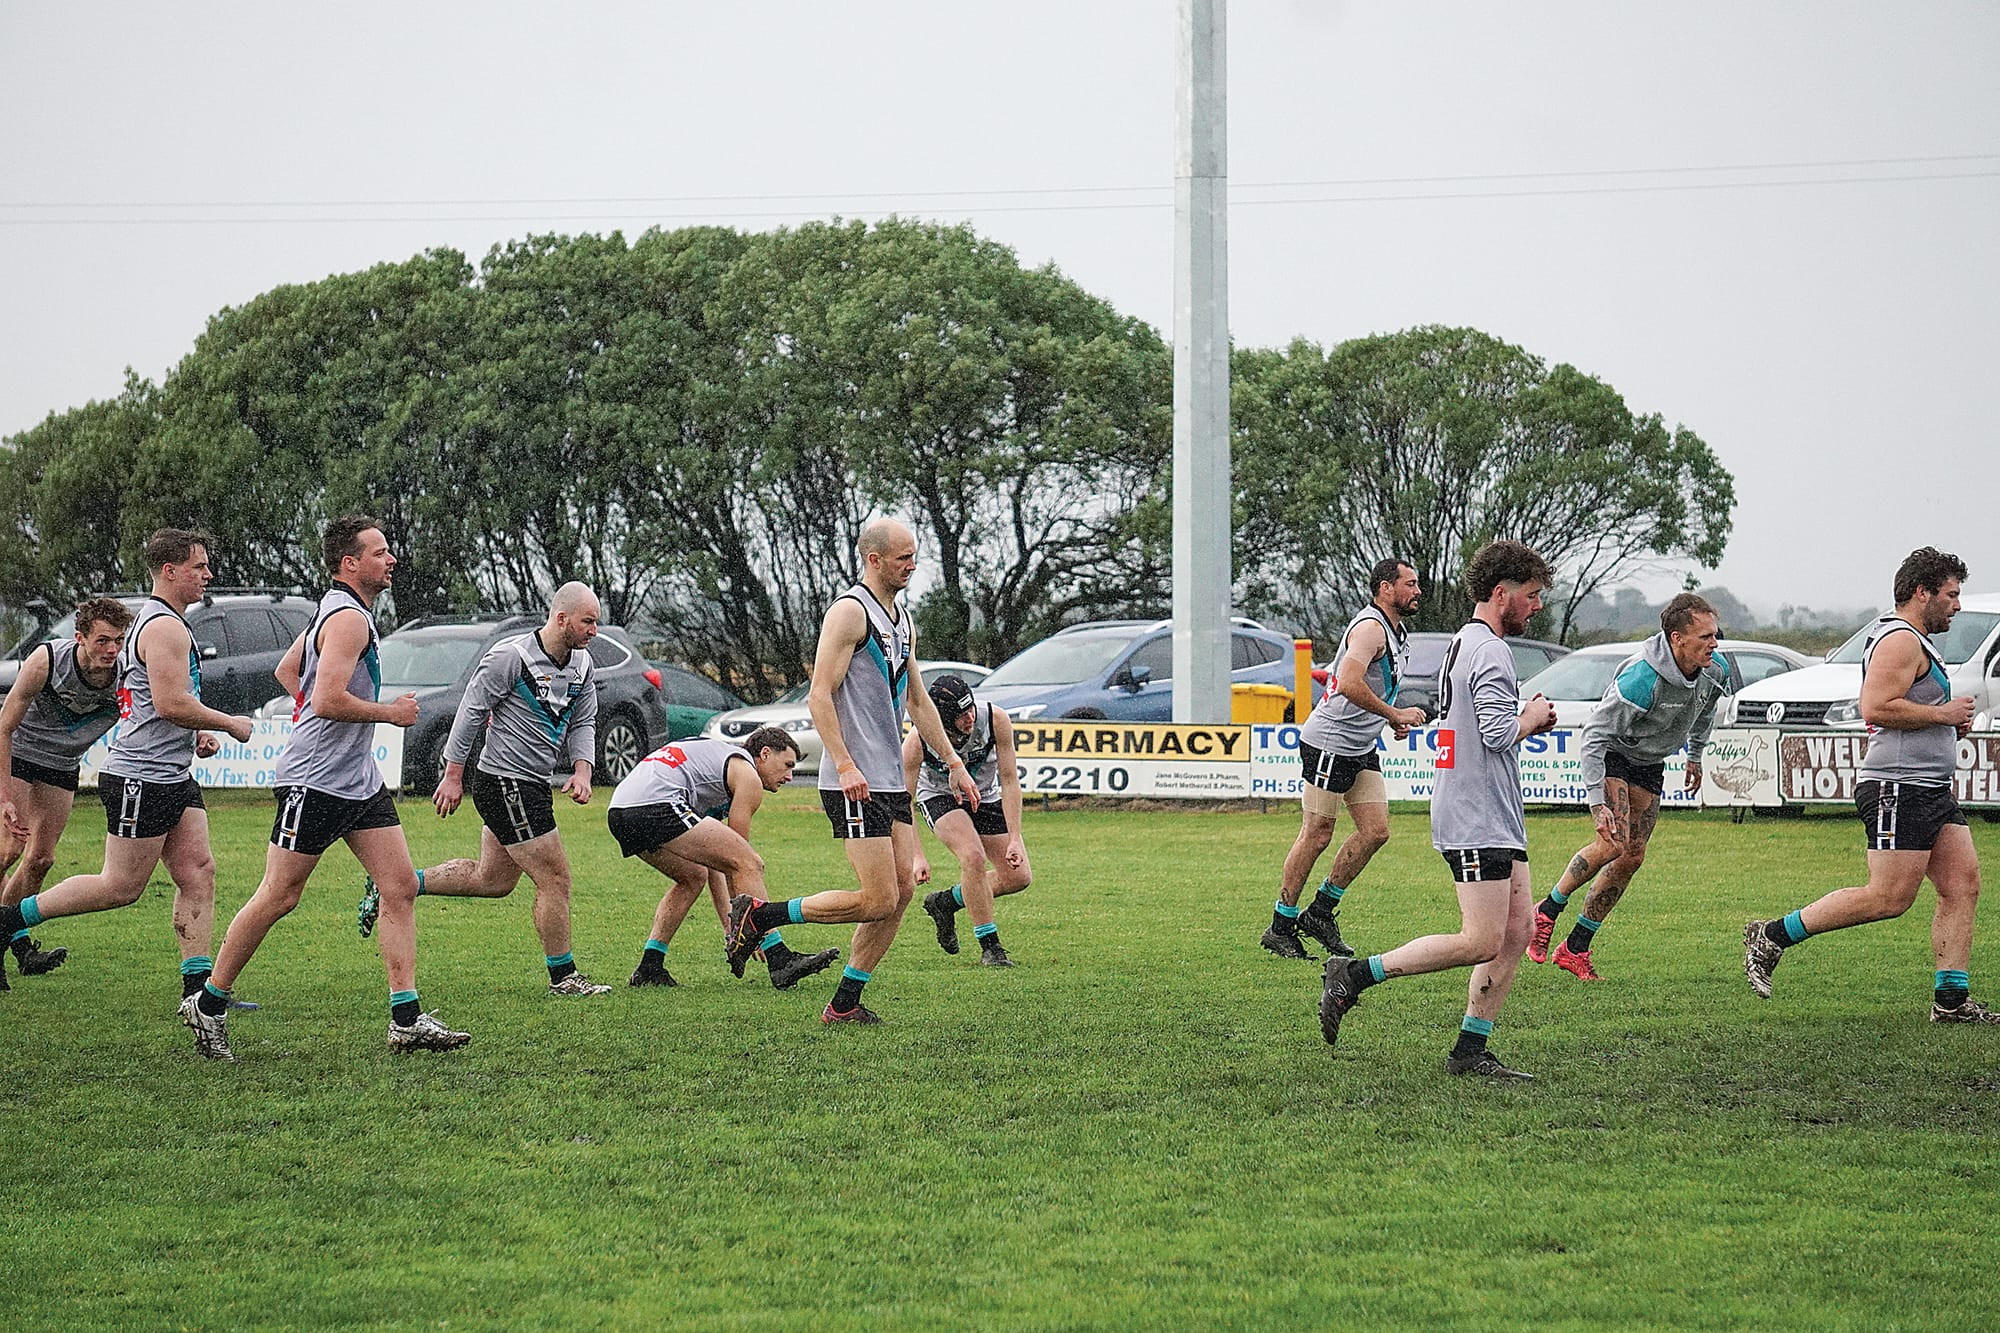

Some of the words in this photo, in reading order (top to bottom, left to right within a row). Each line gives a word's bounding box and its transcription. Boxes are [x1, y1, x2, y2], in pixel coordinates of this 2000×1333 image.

[1013, 729, 1242, 755] PHARMACY
[1253, 727, 1301, 750] TO
[1518, 730, 1572, 754] ST
[214, 743, 258, 760] obile:
[263, 744, 285, 760] 04
[1706, 741, 1747, 762] Daffy's
[1267, 756, 1295, 764] STAR
[1520, 760, 1550, 769] POOL
[1552, 760, 1560, 769] &
[255, 769, 276, 785] 03
[1036, 765, 1130, 792] 2210
[1252, 779, 1282, 792] PH:
[1287, 779, 1304, 793] 56
[1520, 773, 1546, 782] ITES
[1953, 769, 2000, 801] TEL
[1522, 784, 1587, 802] ouristp
